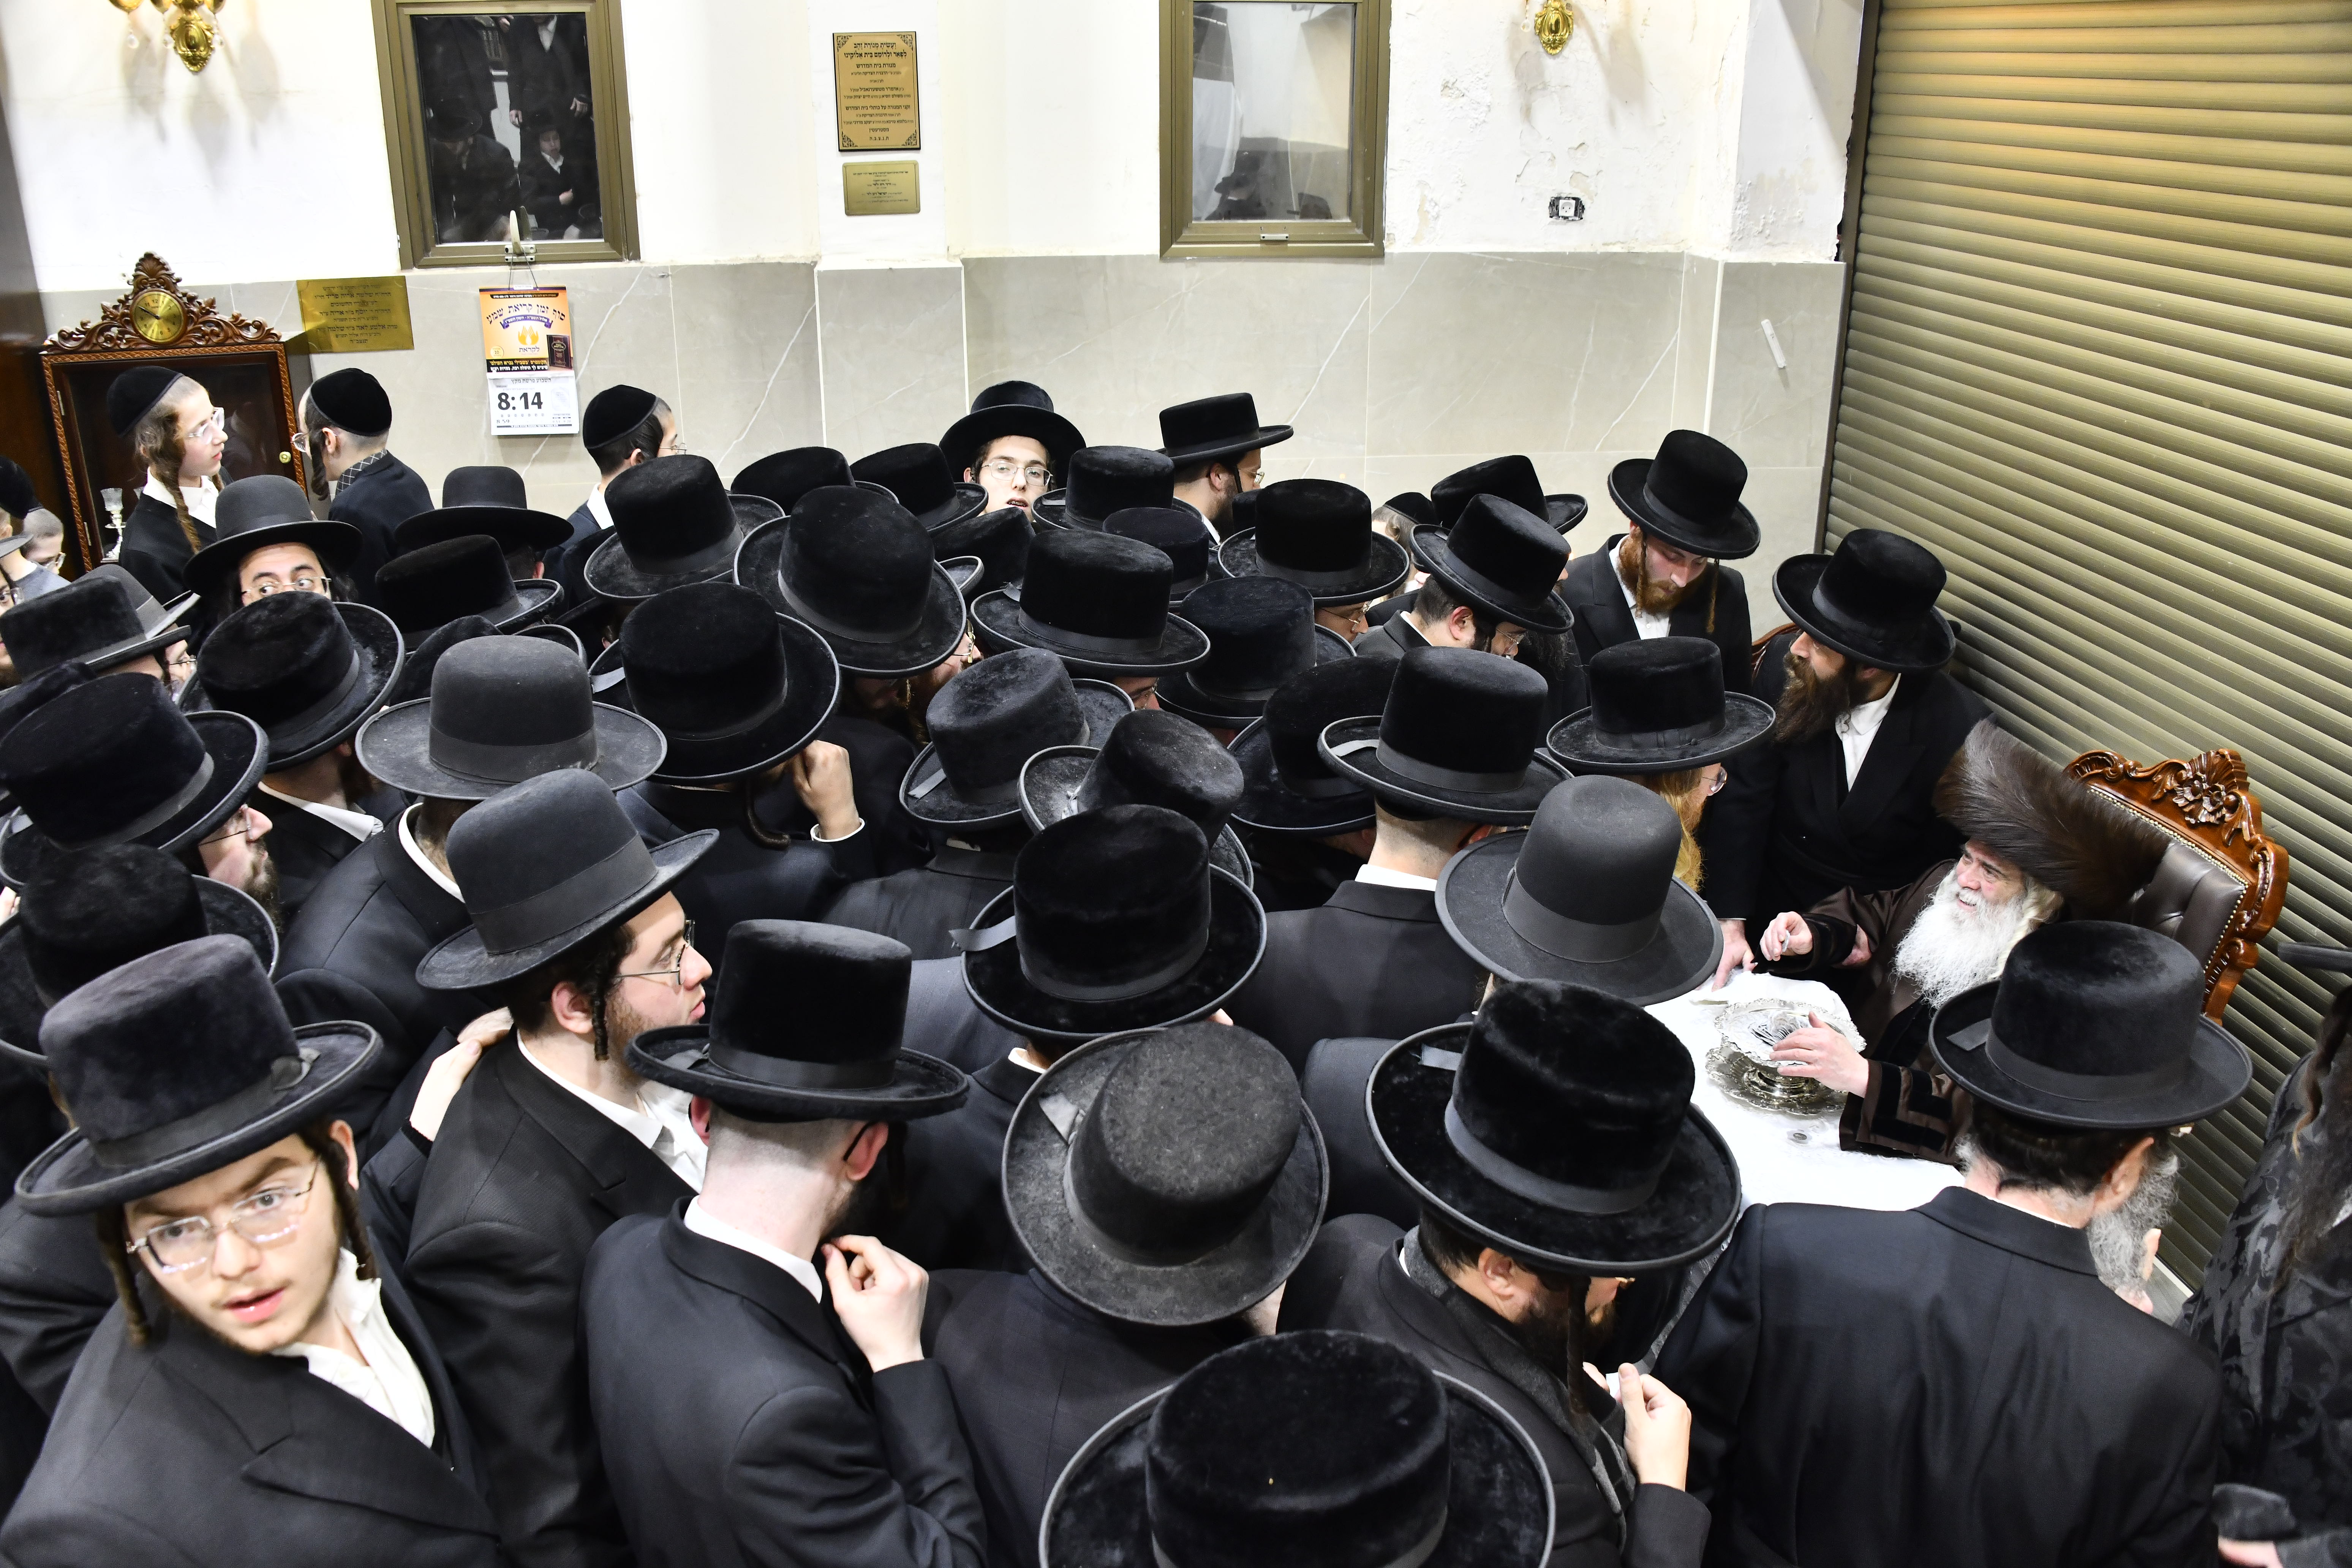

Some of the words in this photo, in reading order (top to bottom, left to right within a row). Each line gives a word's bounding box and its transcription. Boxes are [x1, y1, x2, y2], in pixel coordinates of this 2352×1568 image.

[508, 303, 533, 313] קריאת
[537, 304, 549, 315] זמן
[487, 308, 503, 325] שמע
[553, 309, 566, 321] סוף
[498, 392, 543, 410] 8:14
